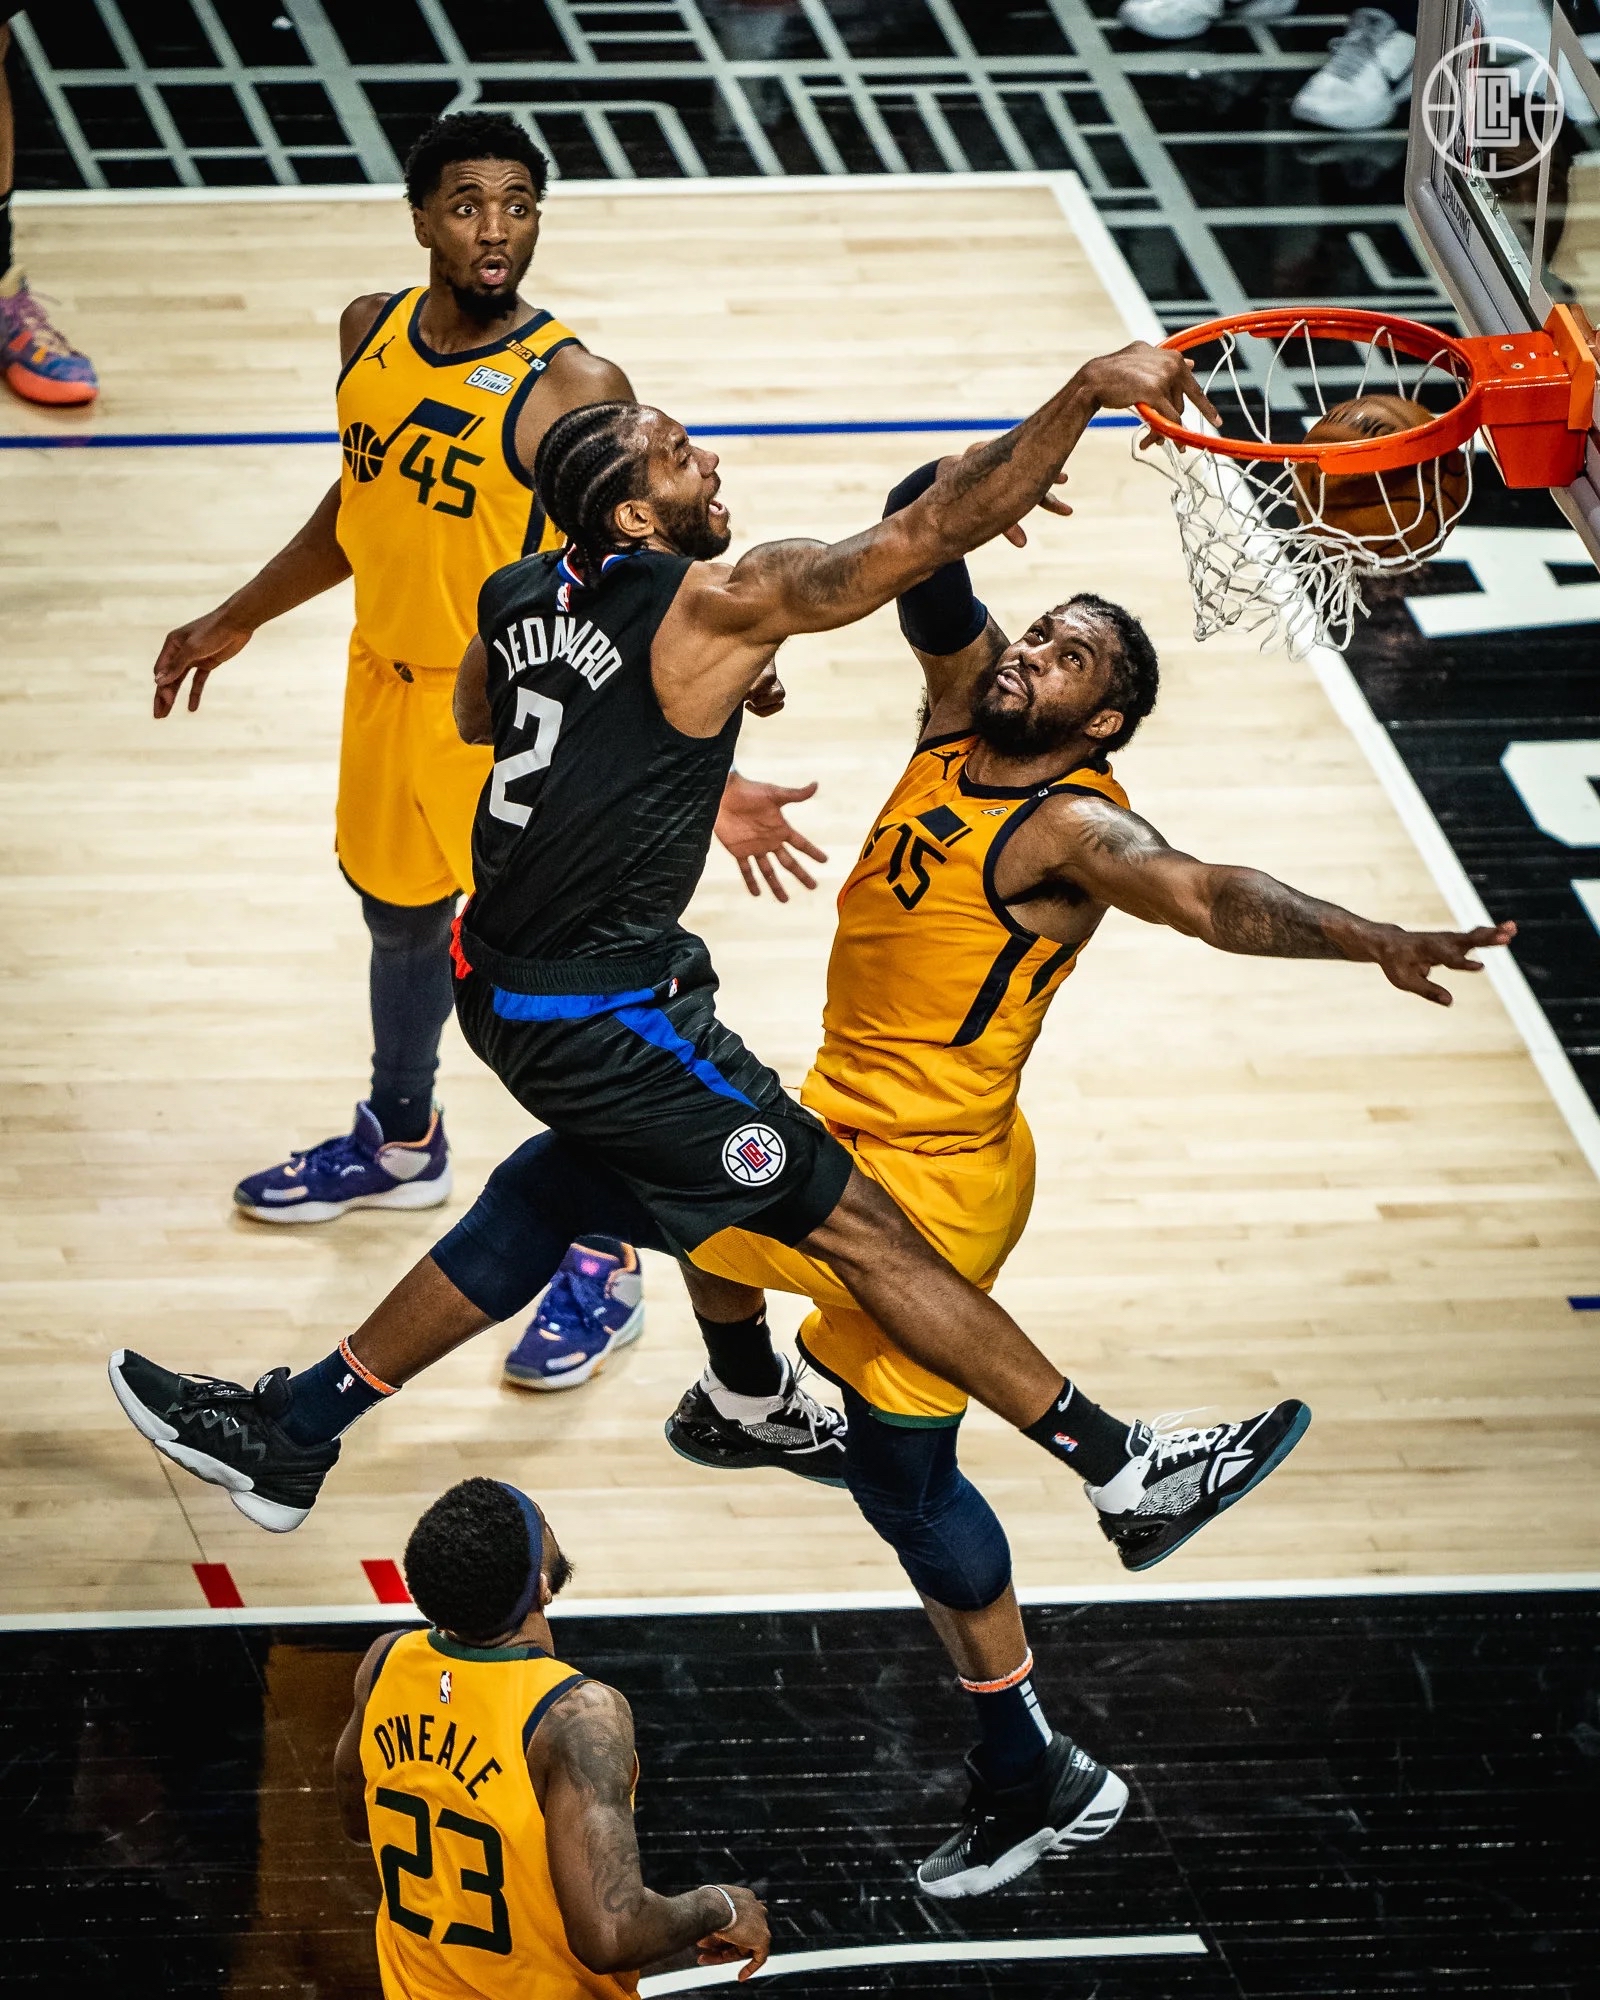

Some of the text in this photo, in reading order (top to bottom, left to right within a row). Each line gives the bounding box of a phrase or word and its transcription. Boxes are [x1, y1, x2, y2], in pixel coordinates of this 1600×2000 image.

[471, 368, 488, 384] 5
[399, 433, 486, 519] 45
[493, 615, 623, 691] LEONARD
[489, 686, 564, 830] 2
[885, 823, 948, 911] 15
[373, 1713, 503, 1800] O'NEALE
[374, 1786, 513, 1956] 23
